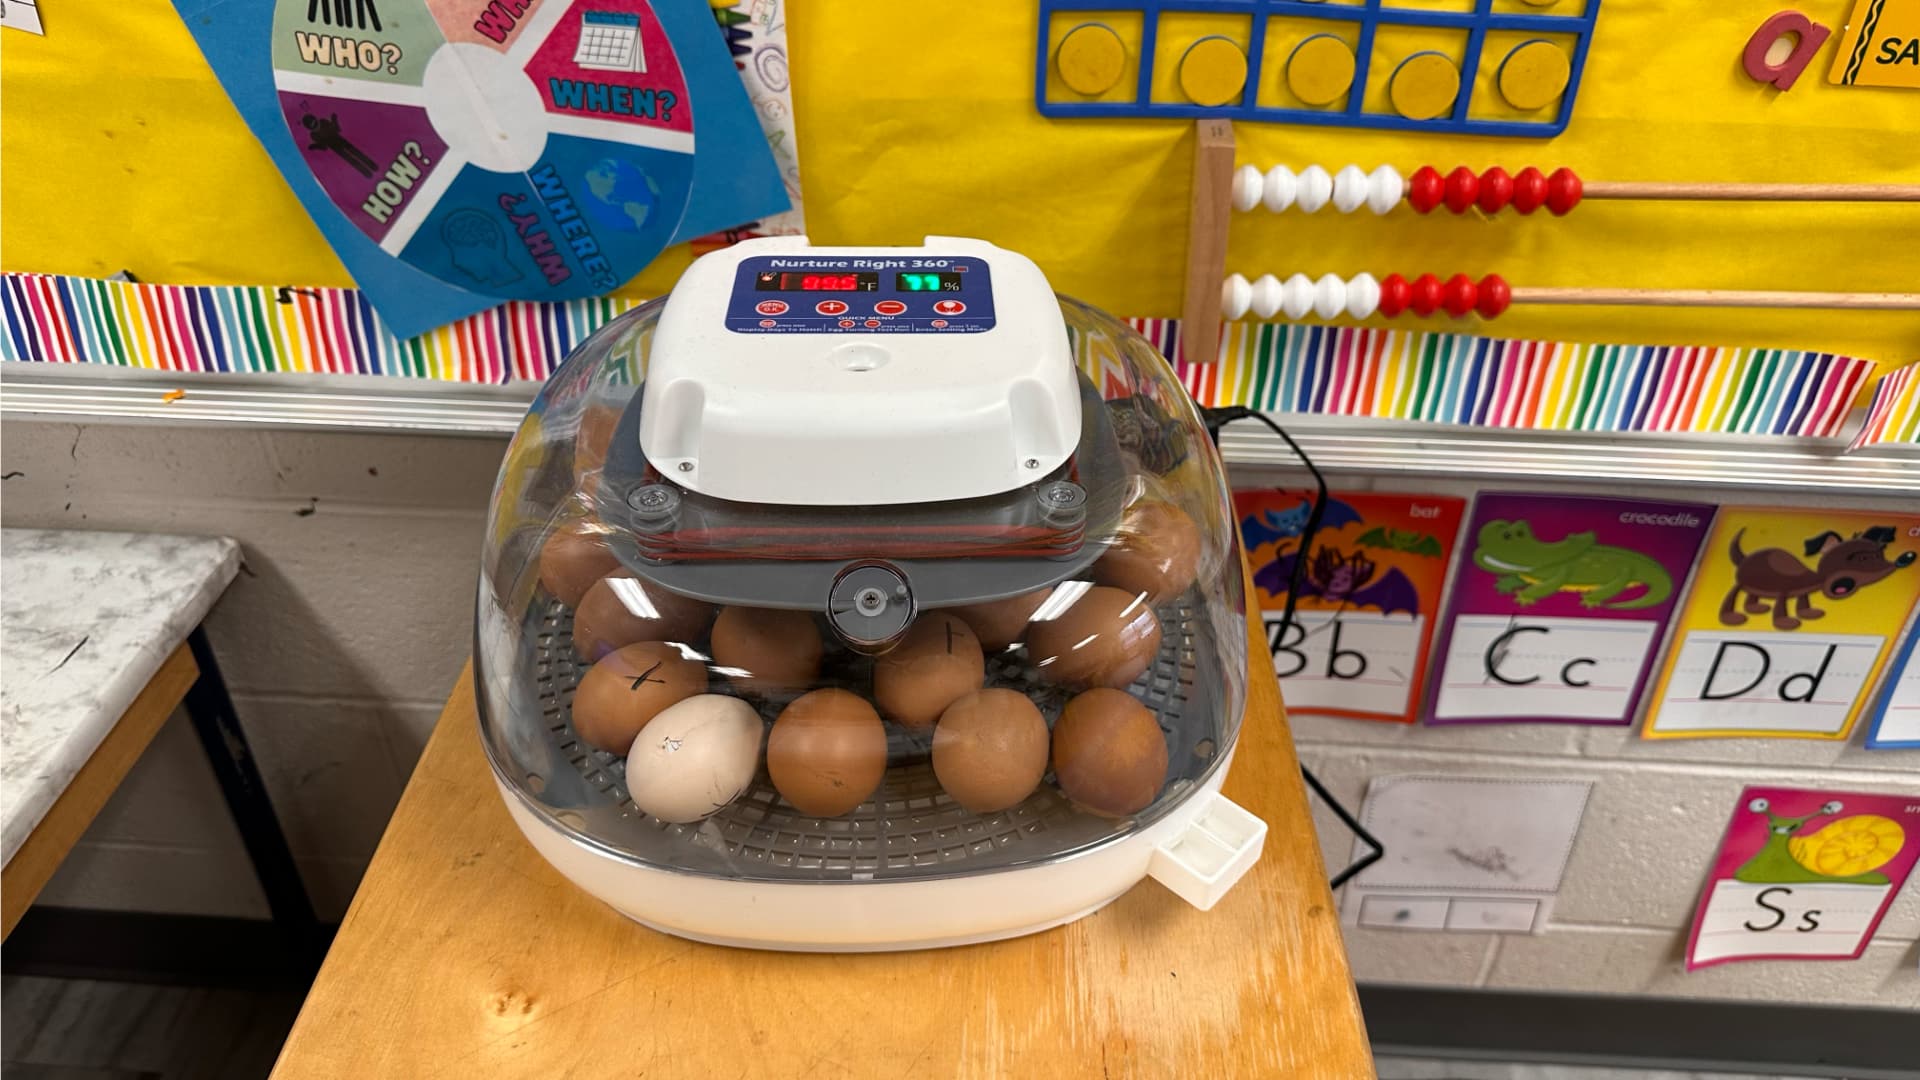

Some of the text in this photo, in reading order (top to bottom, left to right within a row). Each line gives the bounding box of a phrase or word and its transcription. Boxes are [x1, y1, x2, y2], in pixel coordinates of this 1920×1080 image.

[295, 31, 402, 75] WHO?
[549, 78, 678, 122] WHEN?
[361, 141, 432, 225] HOW?
[499, 192, 571, 287] WHY?
[532, 164, 620, 291] WHERE?
[770, 259, 849, 268] Nurture
[853, 259, 907, 271] Right
[944, 281, 960, 292] %
[1409, 503, 1441, 519] bat
[1619, 510, 1700, 528] crocodile
